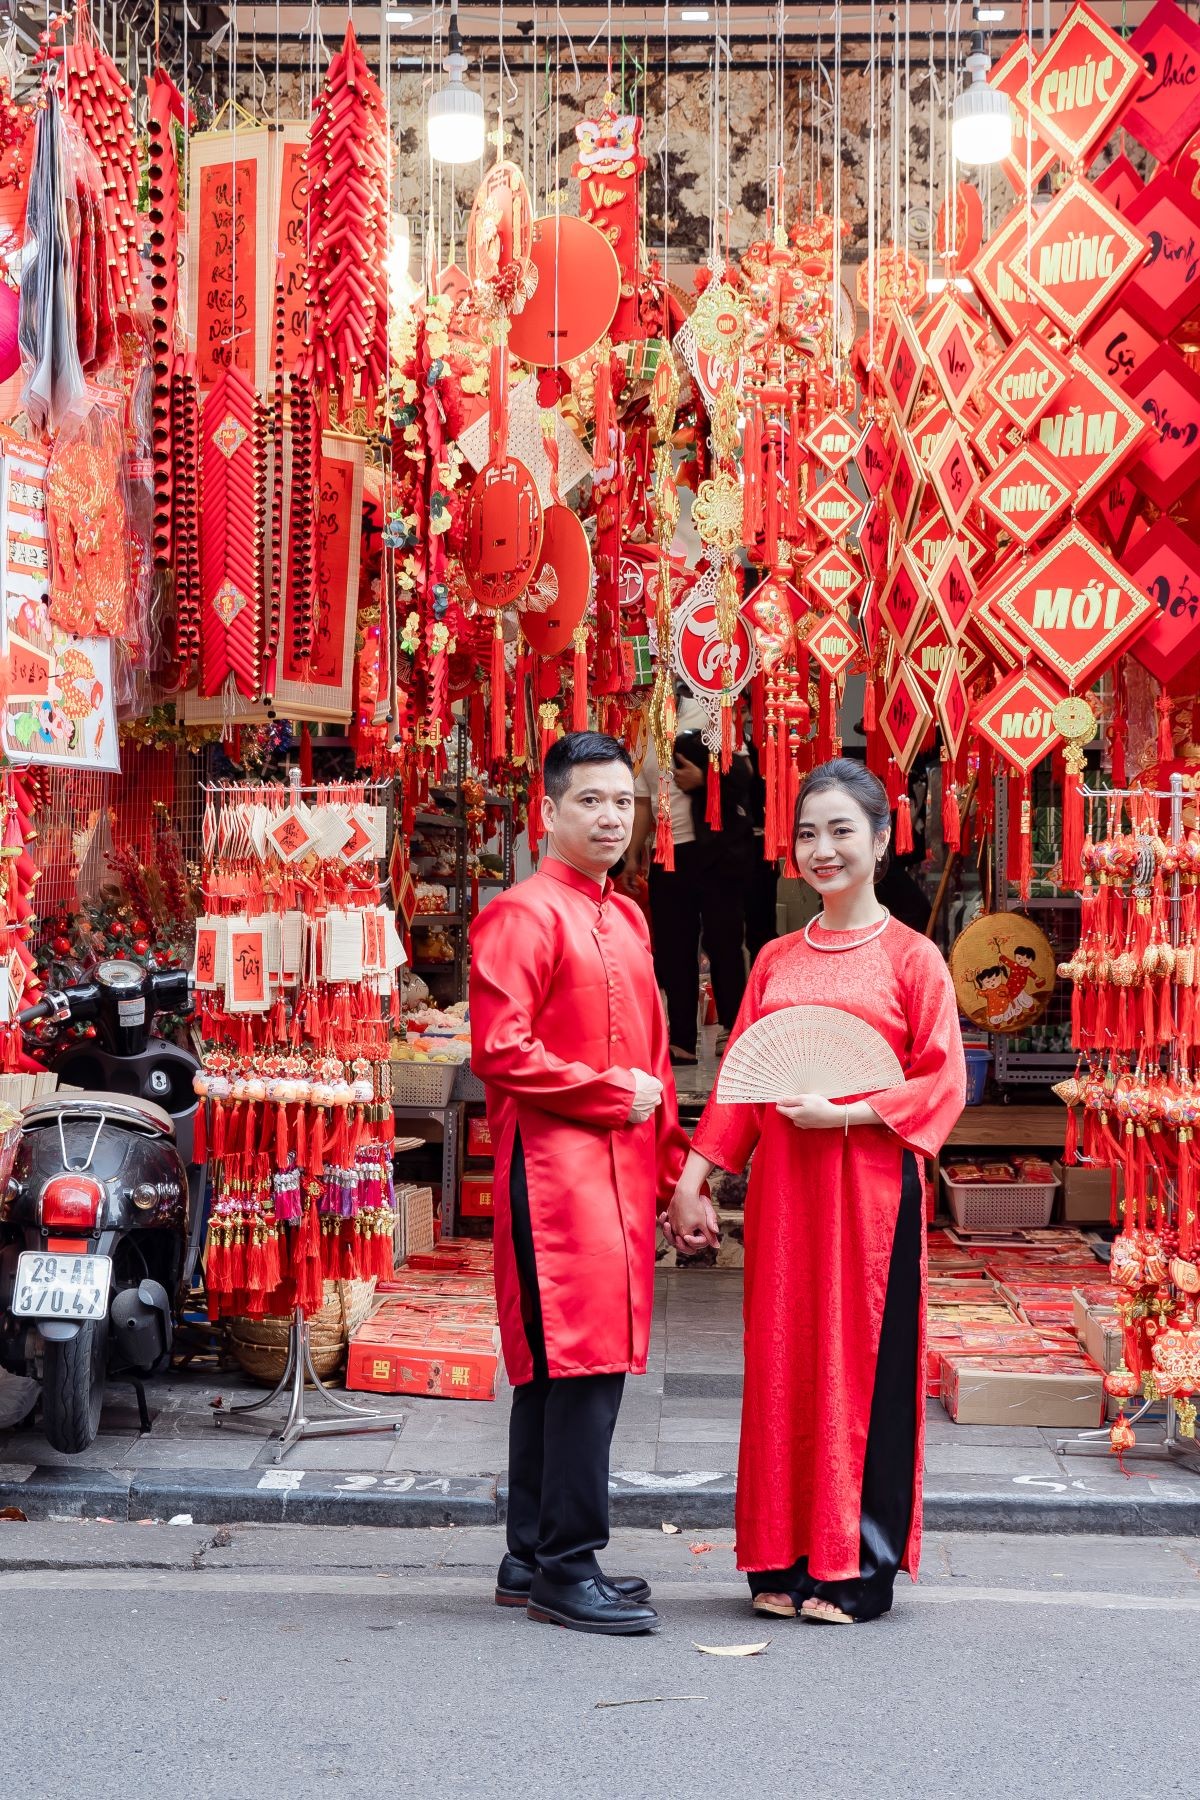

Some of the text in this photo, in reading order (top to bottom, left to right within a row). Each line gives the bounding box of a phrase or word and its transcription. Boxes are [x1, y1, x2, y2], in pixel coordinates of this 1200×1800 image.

[1040, 54, 1113, 114] CHÚC
[1038, 231, 1115, 286] MỪNG
[1104, 331, 1136, 376] Sự
[1000, 366, 1049, 402] CHÚC
[821, 433, 851, 453] AN
[1038, 404, 1118, 458] NĂM
[817, 501, 850, 520] KHANG
[1000, 480, 1051, 513] MỪNG
[921, 539, 970, 565] THH
[820, 568, 852, 591] THỊNH
[1032, 578, 1121, 630] MỚI
[820, 634, 849, 659] VƯỢNG
[1001, 706, 1052, 739] MỚI
[30, 1257, 95, 1285] 29-AA
